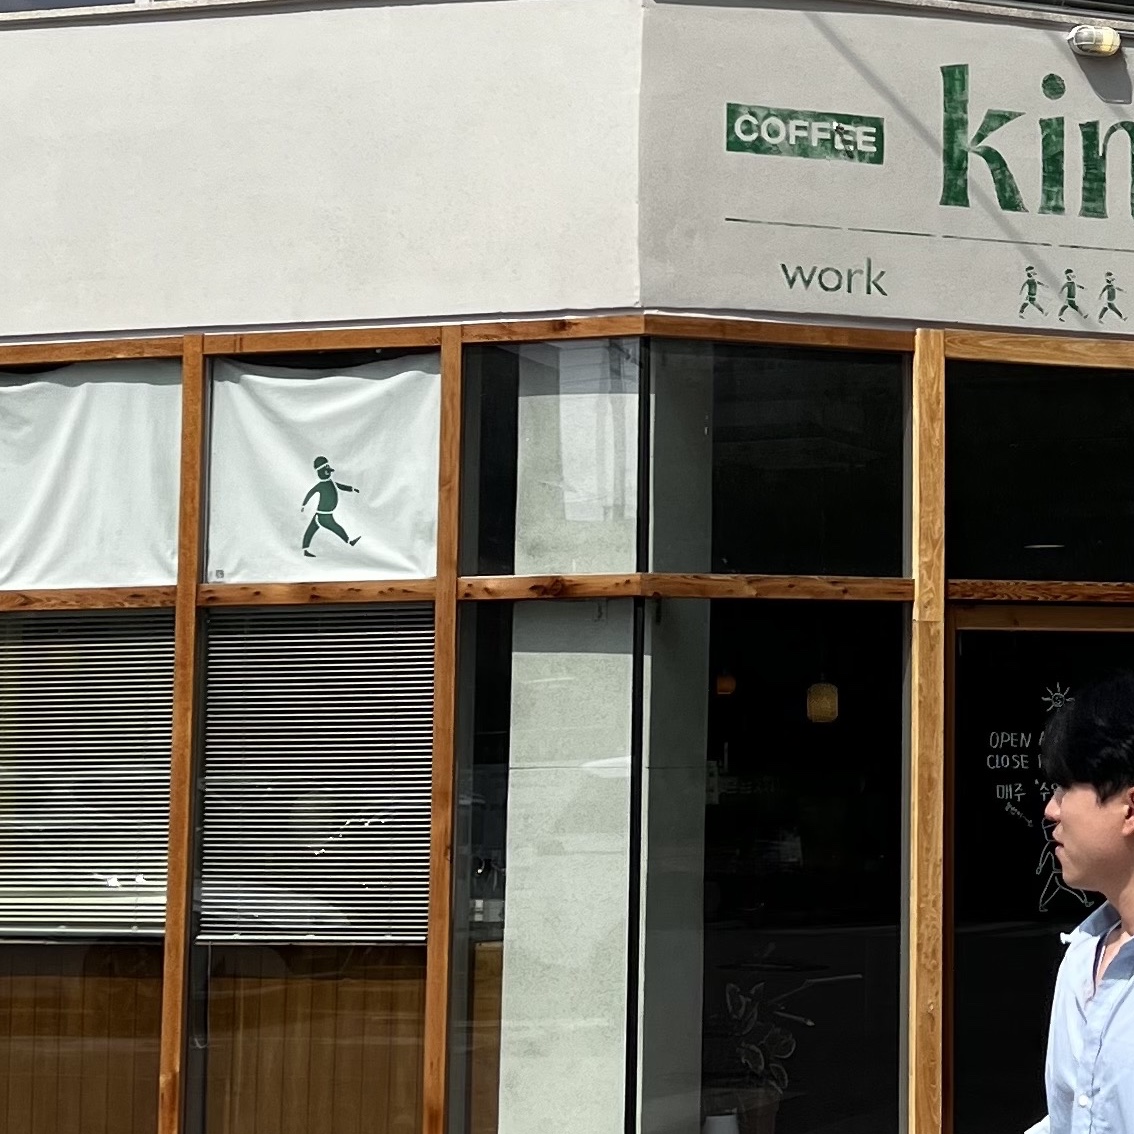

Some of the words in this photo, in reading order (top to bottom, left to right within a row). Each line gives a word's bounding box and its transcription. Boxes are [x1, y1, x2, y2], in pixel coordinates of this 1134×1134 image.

[735, 113, 877, 153] COFFEE
[781, 256, 888, 297] work
[989, 731, 1032, 749] OPEN
[987, 754, 1029, 770] CLOSE
[996, 782, 1026, 802] 매주
